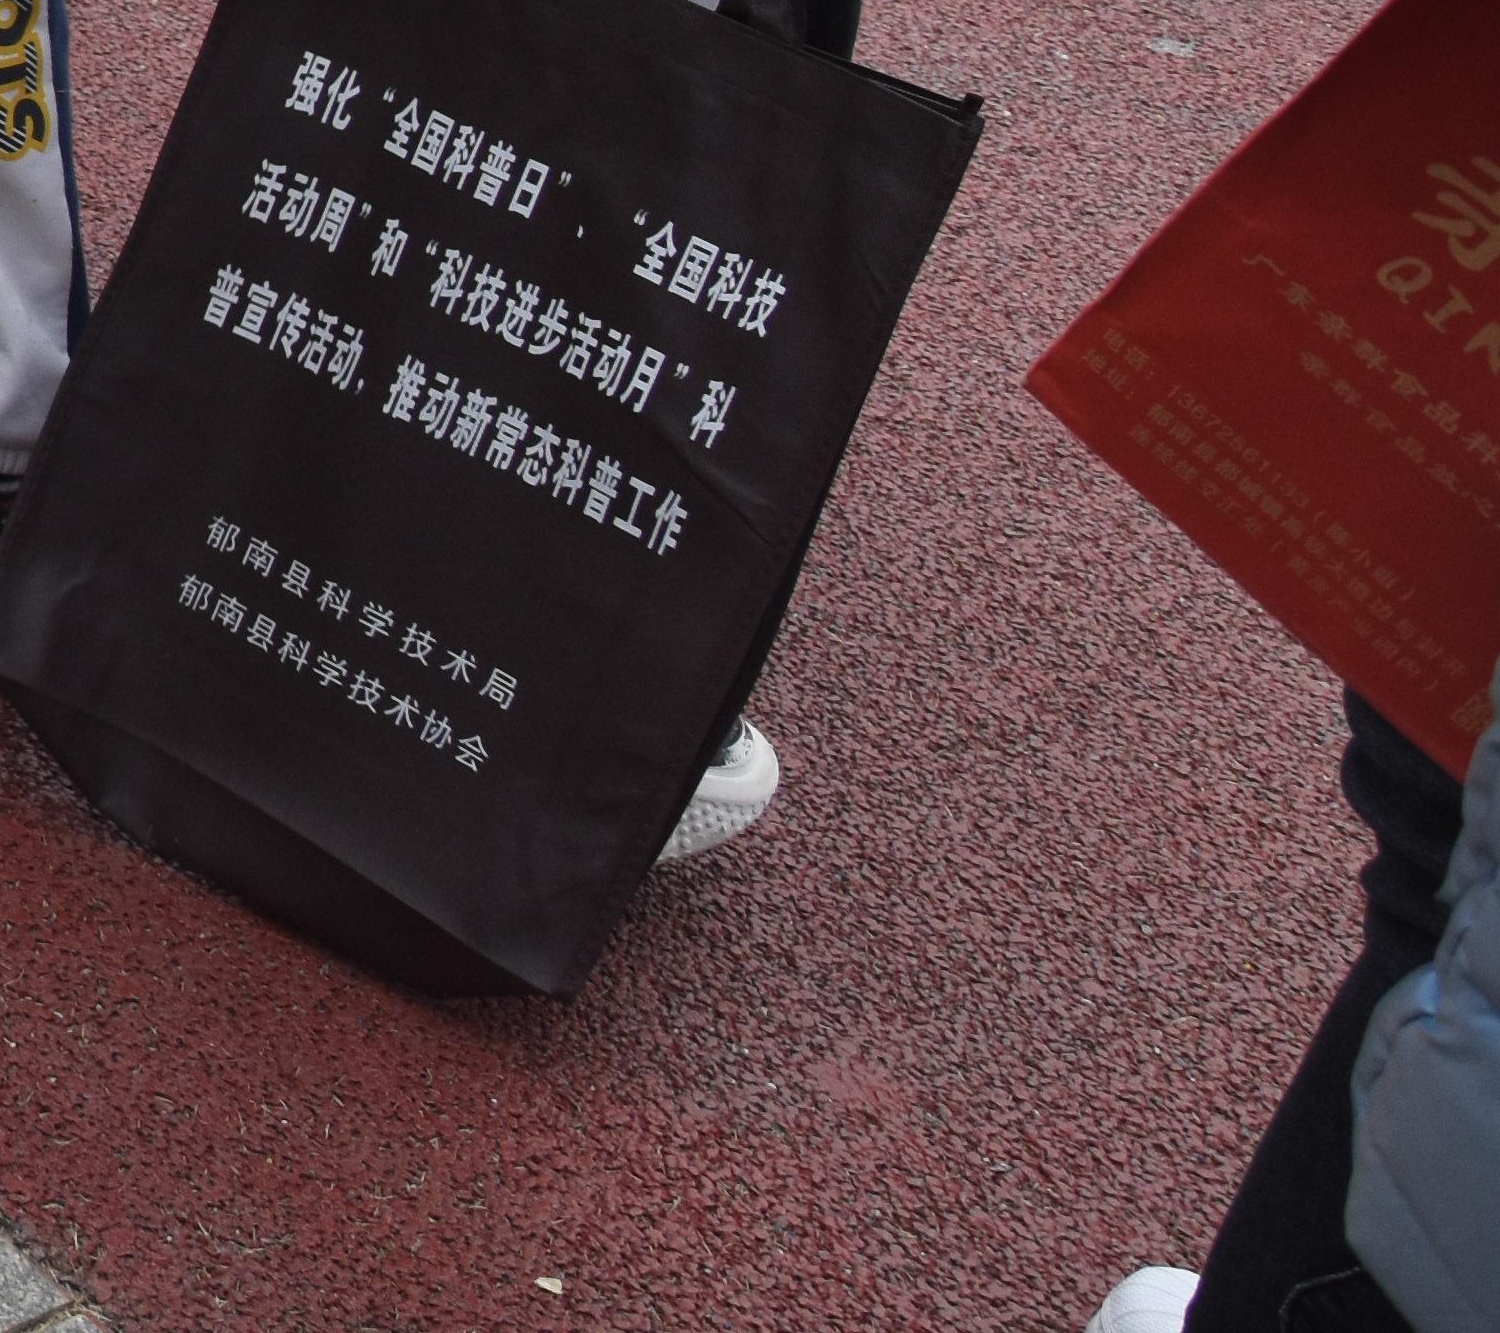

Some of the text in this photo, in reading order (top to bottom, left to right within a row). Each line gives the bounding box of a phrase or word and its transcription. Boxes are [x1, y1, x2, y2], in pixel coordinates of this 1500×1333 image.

[178, 573, 490, 772] 郁南县科学技术协会
[206, 515, 518, 710] 郁南县科学技术局
